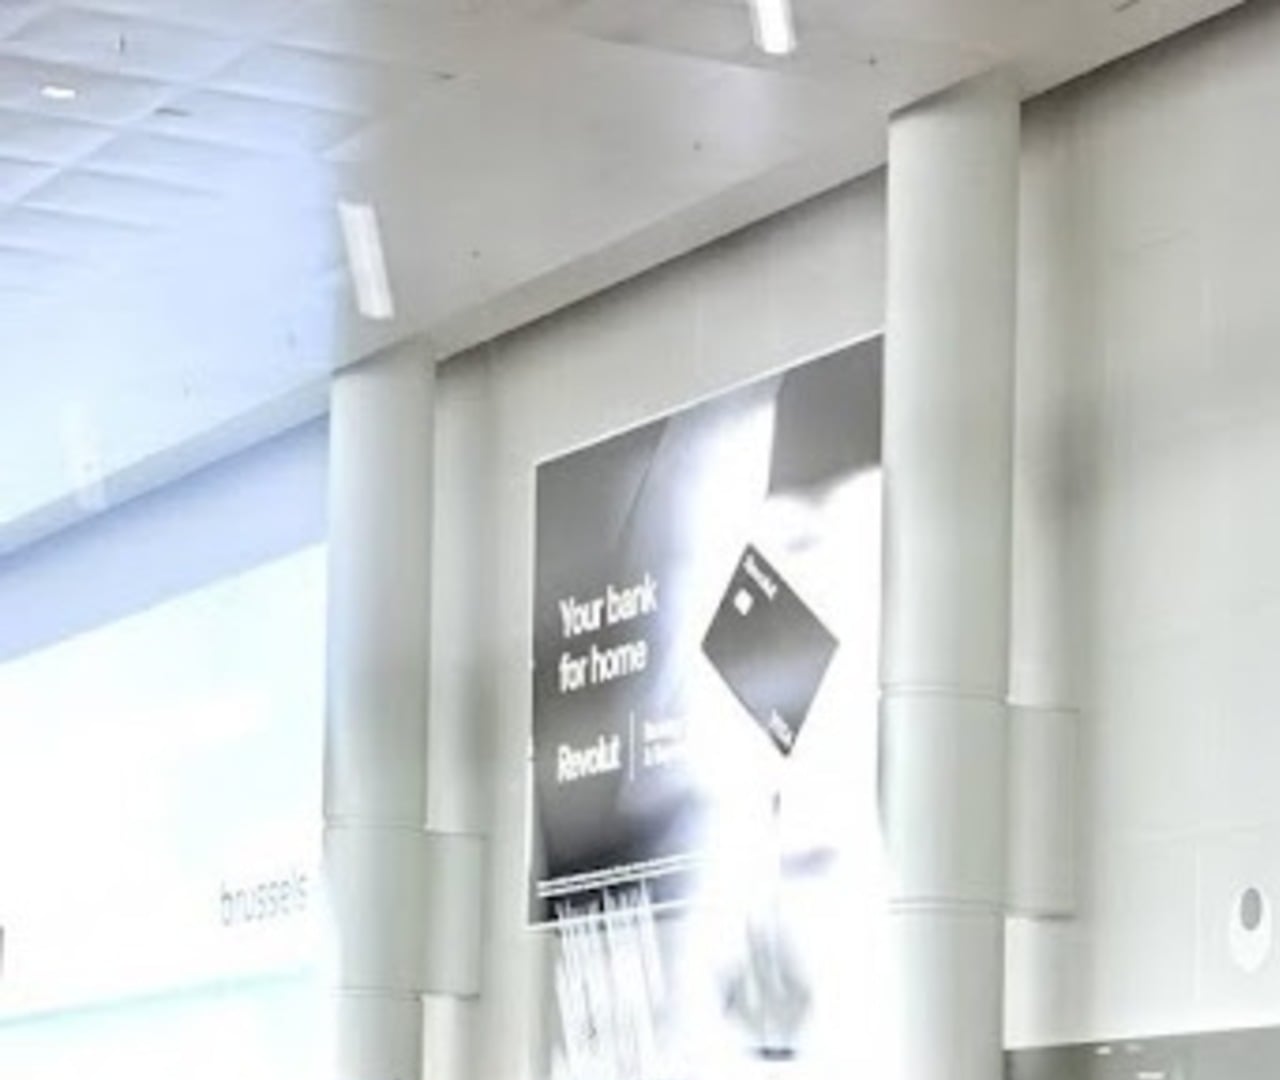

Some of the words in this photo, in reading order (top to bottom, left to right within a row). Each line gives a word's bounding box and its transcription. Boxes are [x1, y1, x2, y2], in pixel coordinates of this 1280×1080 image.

[558, 596, 604, 638] Your
[606, 571, 659, 625] bank
[558, 651, 588, 693] for
[590, 640, 648, 684] home
[557, 734, 621, 783] Revolut
